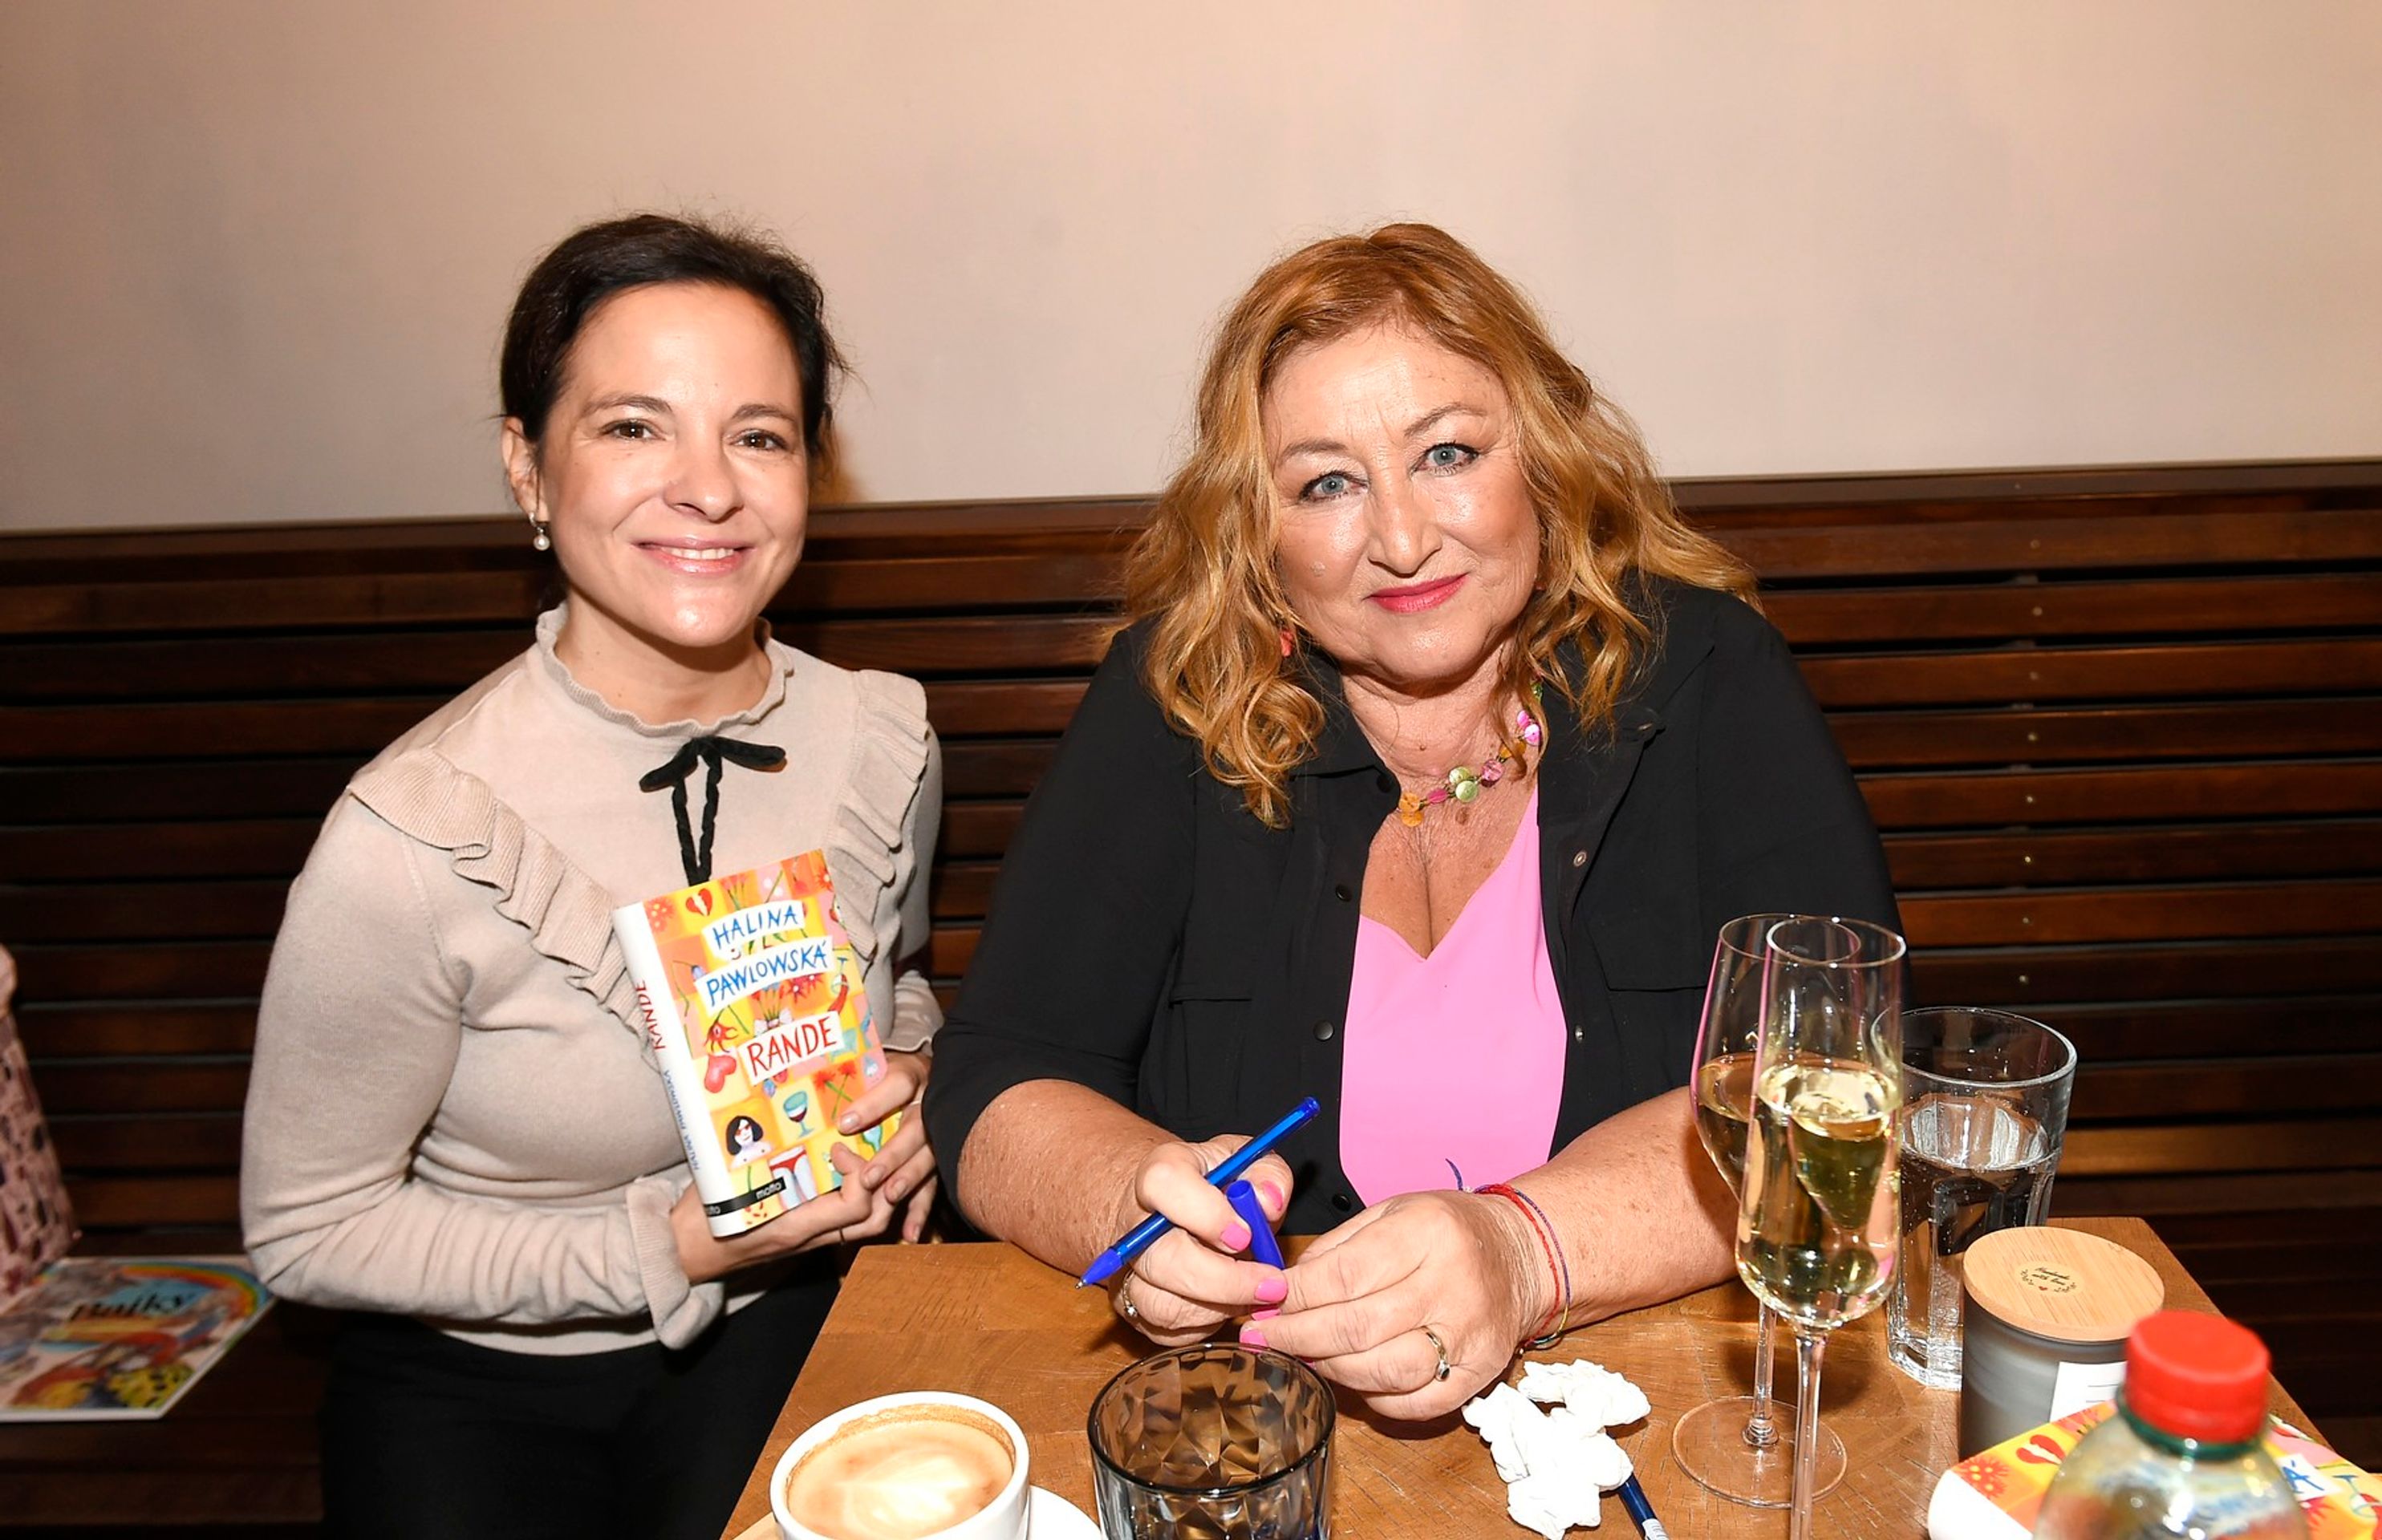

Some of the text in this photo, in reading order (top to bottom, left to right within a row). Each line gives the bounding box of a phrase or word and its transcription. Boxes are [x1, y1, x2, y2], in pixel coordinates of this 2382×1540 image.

[712, 905, 797, 950] HALINA
[706, 939, 828, 1007] PAWLOWSKÁ
[747, 1015, 837, 1076] RANDE
